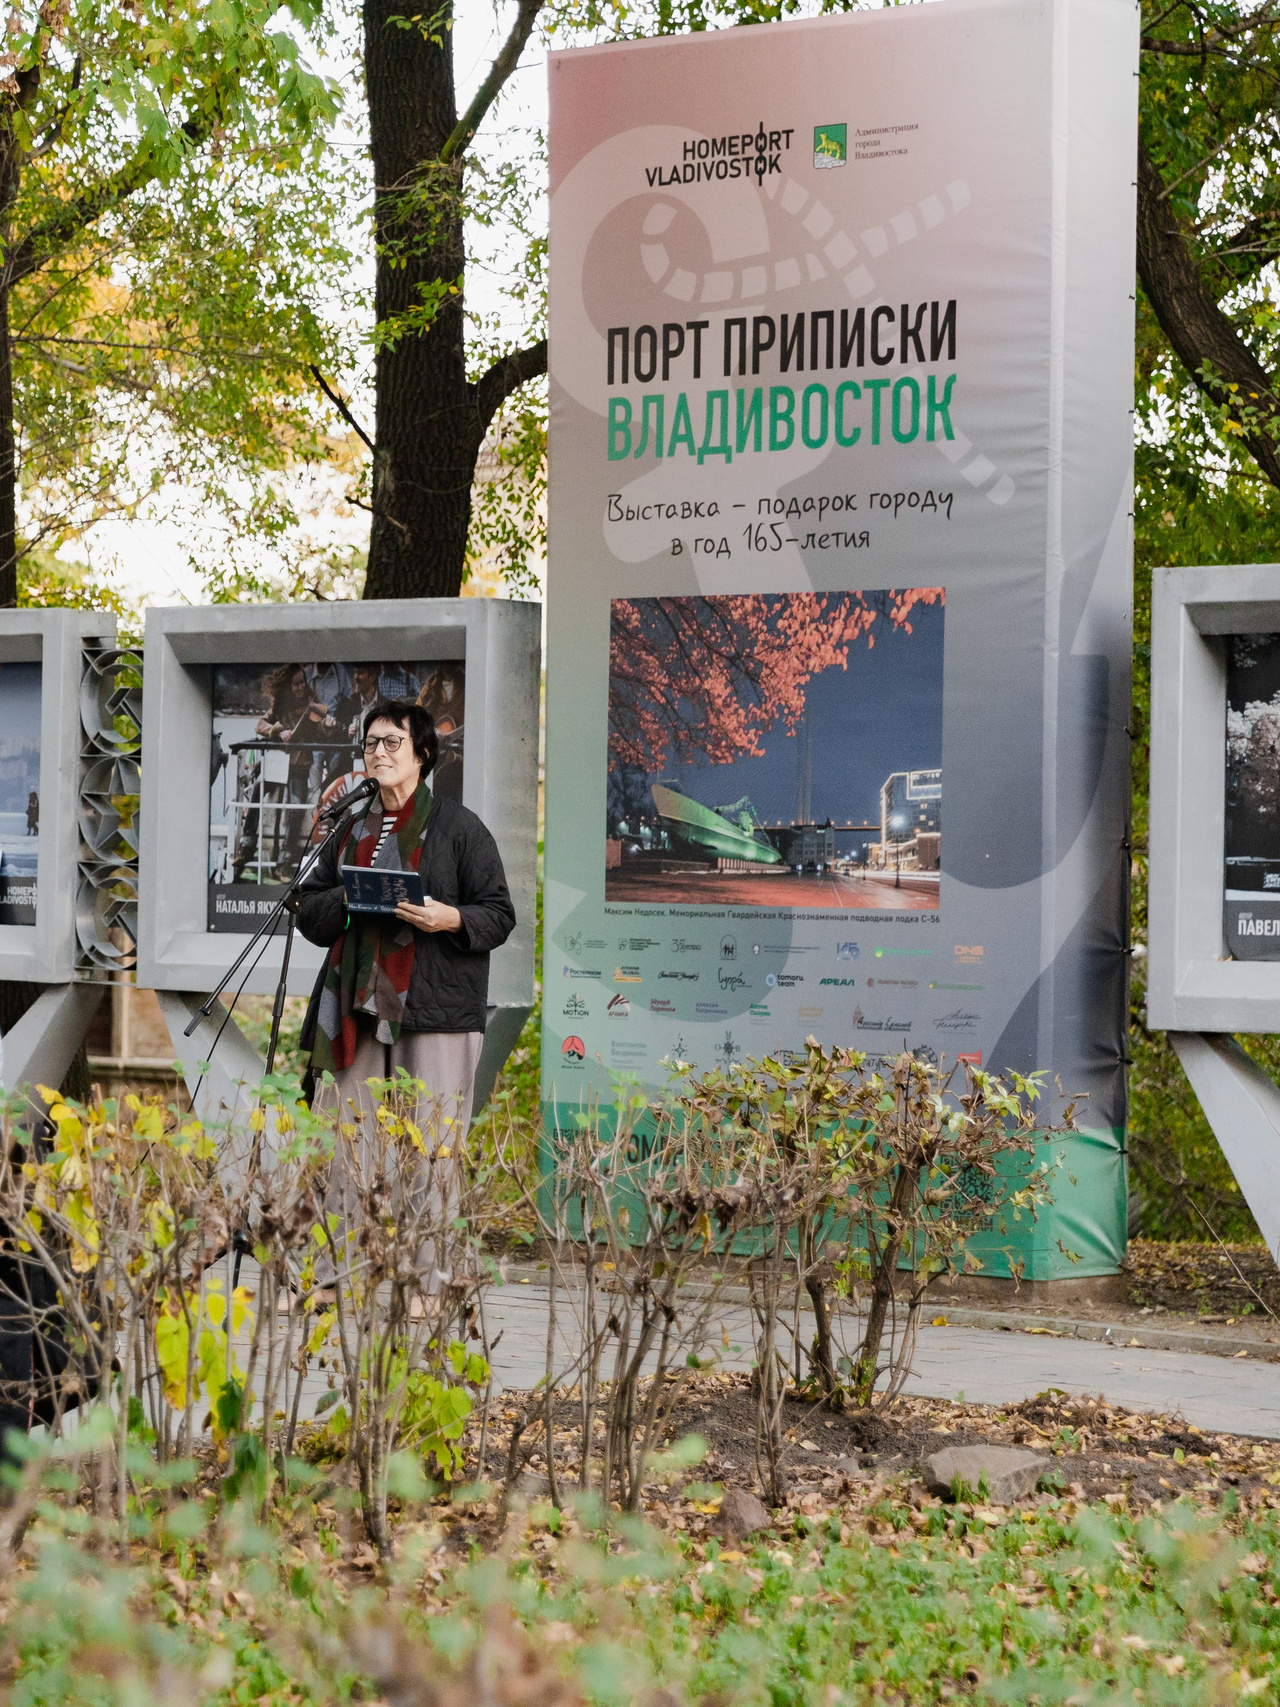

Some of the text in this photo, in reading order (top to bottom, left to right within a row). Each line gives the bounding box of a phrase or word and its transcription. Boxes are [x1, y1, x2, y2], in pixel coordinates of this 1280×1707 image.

[854, 123, 919, 137] Администрация
[683, 126, 795, 161] HOMEPORT
[854, 138, 881, 150] города
[854, 148, 909, 160] Владивостока
[645, 153, 782, 187] VLADIVOSTOK
[606, 300, 957, 385] ПОРТ ПРИПИСКИ
[606, 373, 958, 466] ВЛАДИВОСТОК
[607, 494, 721, 522] Выставка
[758, 492, 858, 522] подарок
[869, 490, 955, 520] городу
[670, 522, 871, 559] в год 165-летия
[216, 900, 256, 914] НАТАЛЬЯ
[604, 907, 633, 916] Максим
[669, 909, 726, 919] Мемориальная
[727, 910, 777, 920] Гвардейская
[778, 911, 849, 921] Краснознаменная
[850, 914, 893, 923] подводная
[895, 914, 919, 923] лодка
[921, 915, 941, 924] С-56
[1238, 919, 1280, 936] ПАВЕЛ
[819, 977, 855, 987] АРЕАЛ
